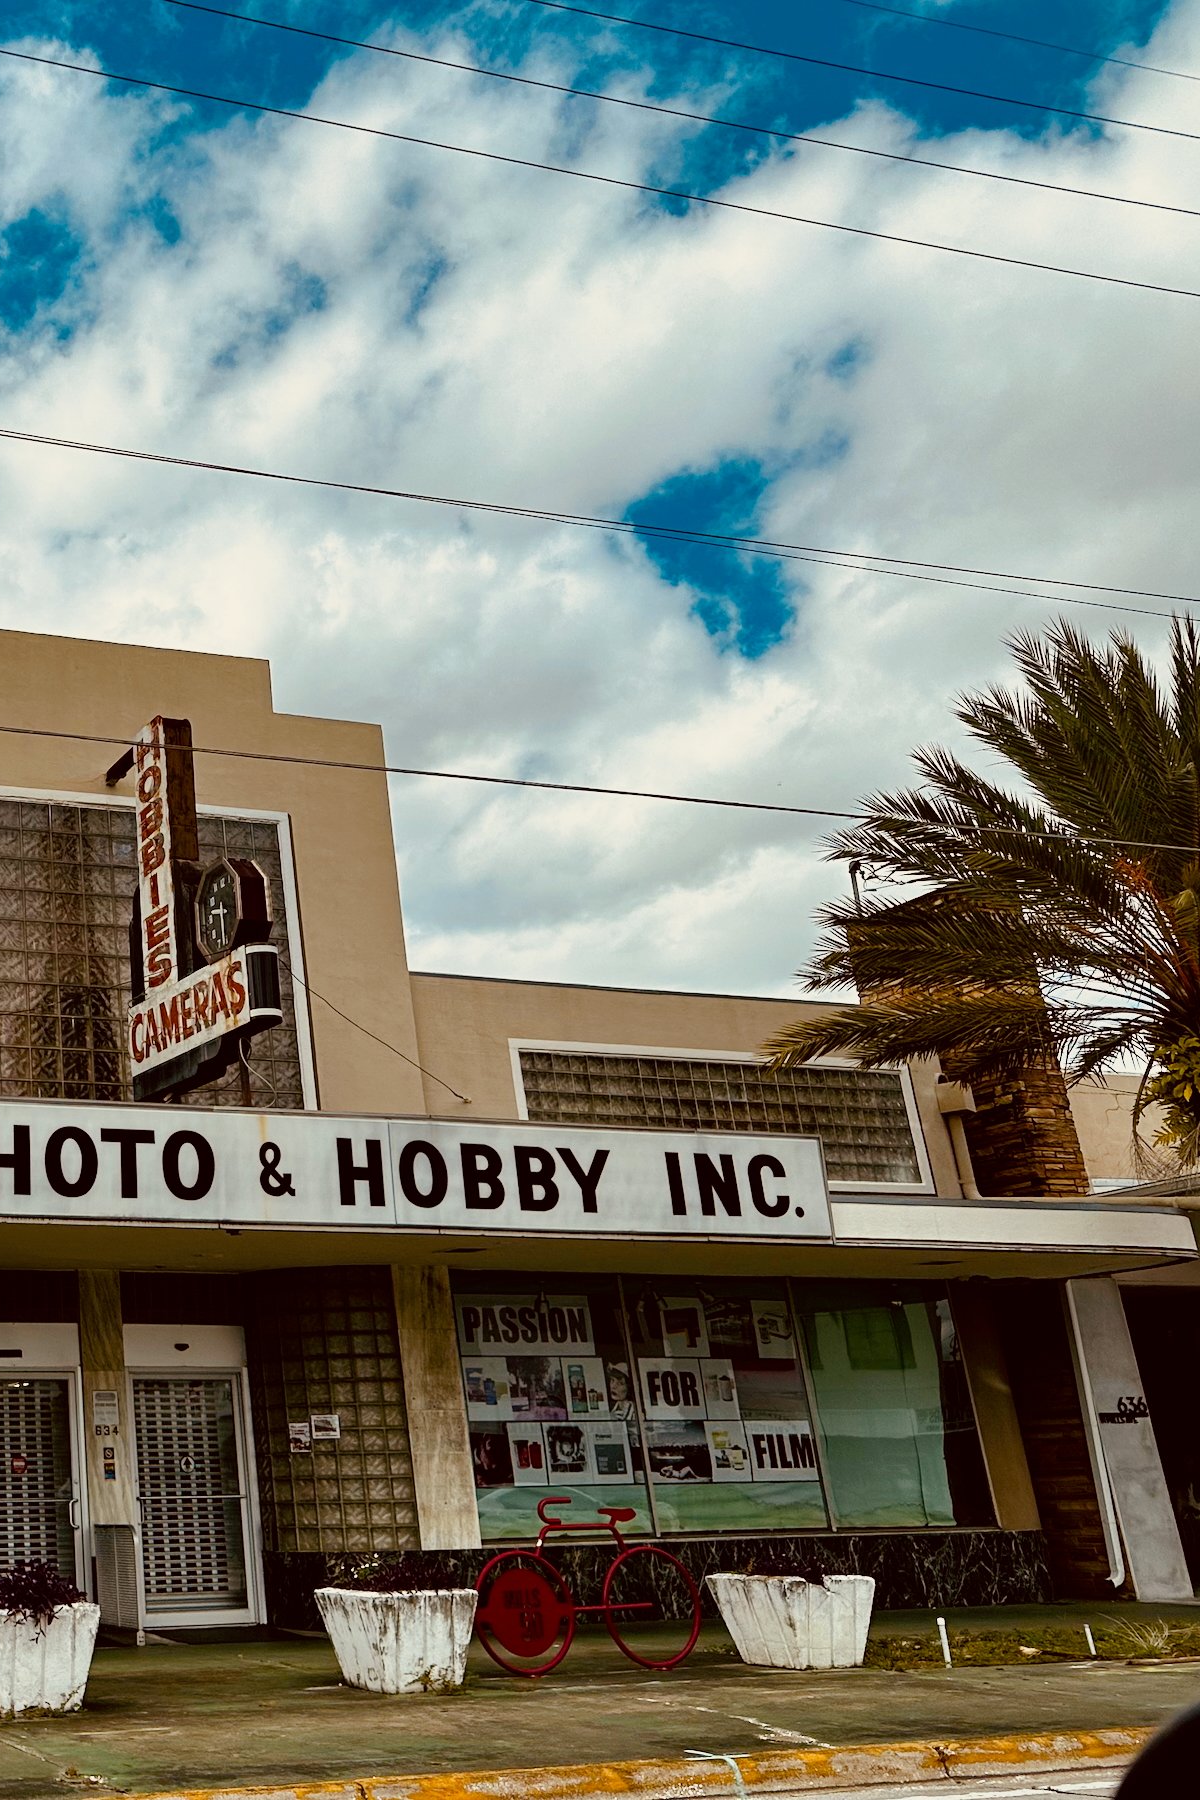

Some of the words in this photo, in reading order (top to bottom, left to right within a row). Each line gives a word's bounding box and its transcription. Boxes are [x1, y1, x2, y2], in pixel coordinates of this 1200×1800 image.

[136, 716, 172, 988] HOBBIES
[131, 960, 246, 1063] CAMERAS
[259, 1141, 296, 1207] &
[336, 1137, 611, 1214] HOBBY
[664, 1151, 805, 1218] INC.
[461, 1306, 589, 1344] PASSION
[646, 1370, 701, 1407] FOR
[1117, 1396, 1148, 1413] 636
[95, 1425, 119, 1436] 634
[751, 1433, 816, 1469] FILM
